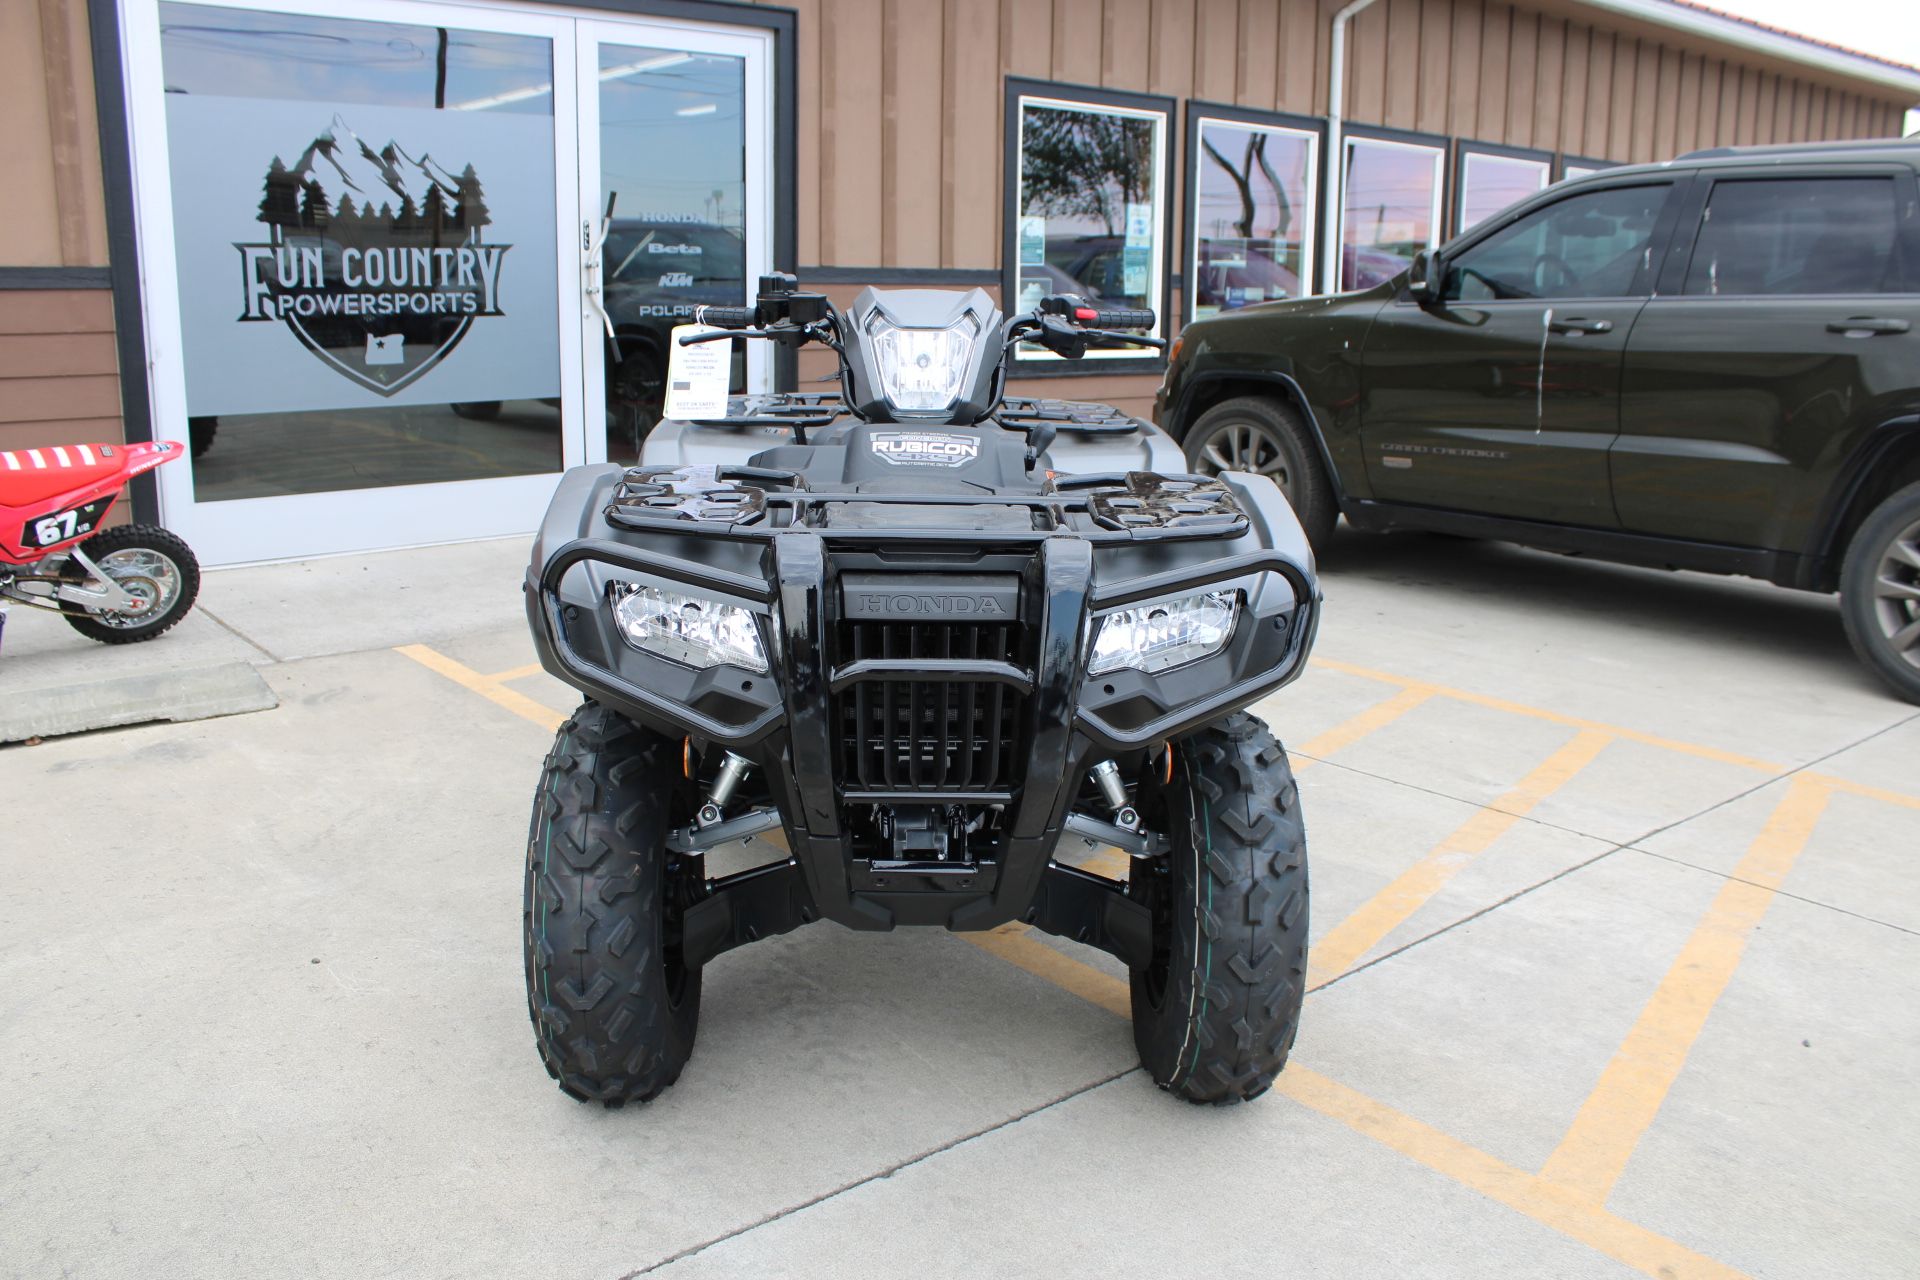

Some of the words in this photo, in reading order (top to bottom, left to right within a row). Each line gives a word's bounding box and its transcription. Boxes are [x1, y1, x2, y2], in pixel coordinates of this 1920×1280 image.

[641, 211, 707, 223] HONDA
[648, 242, 703, 255] Beta
[243, 247, 325, 319] FUN
[341, 247, 502, 312] COUNTRY
[658, 272, 694, 287] KTM
[278, 292, 478, 317] POWERSPORTS
[639, 305, 692, 317] POLAR
[872, 440, 978, 457] RUBICON
[35, 509, 78, 546] 67
[859, 594, 1007, 615] HONDA
